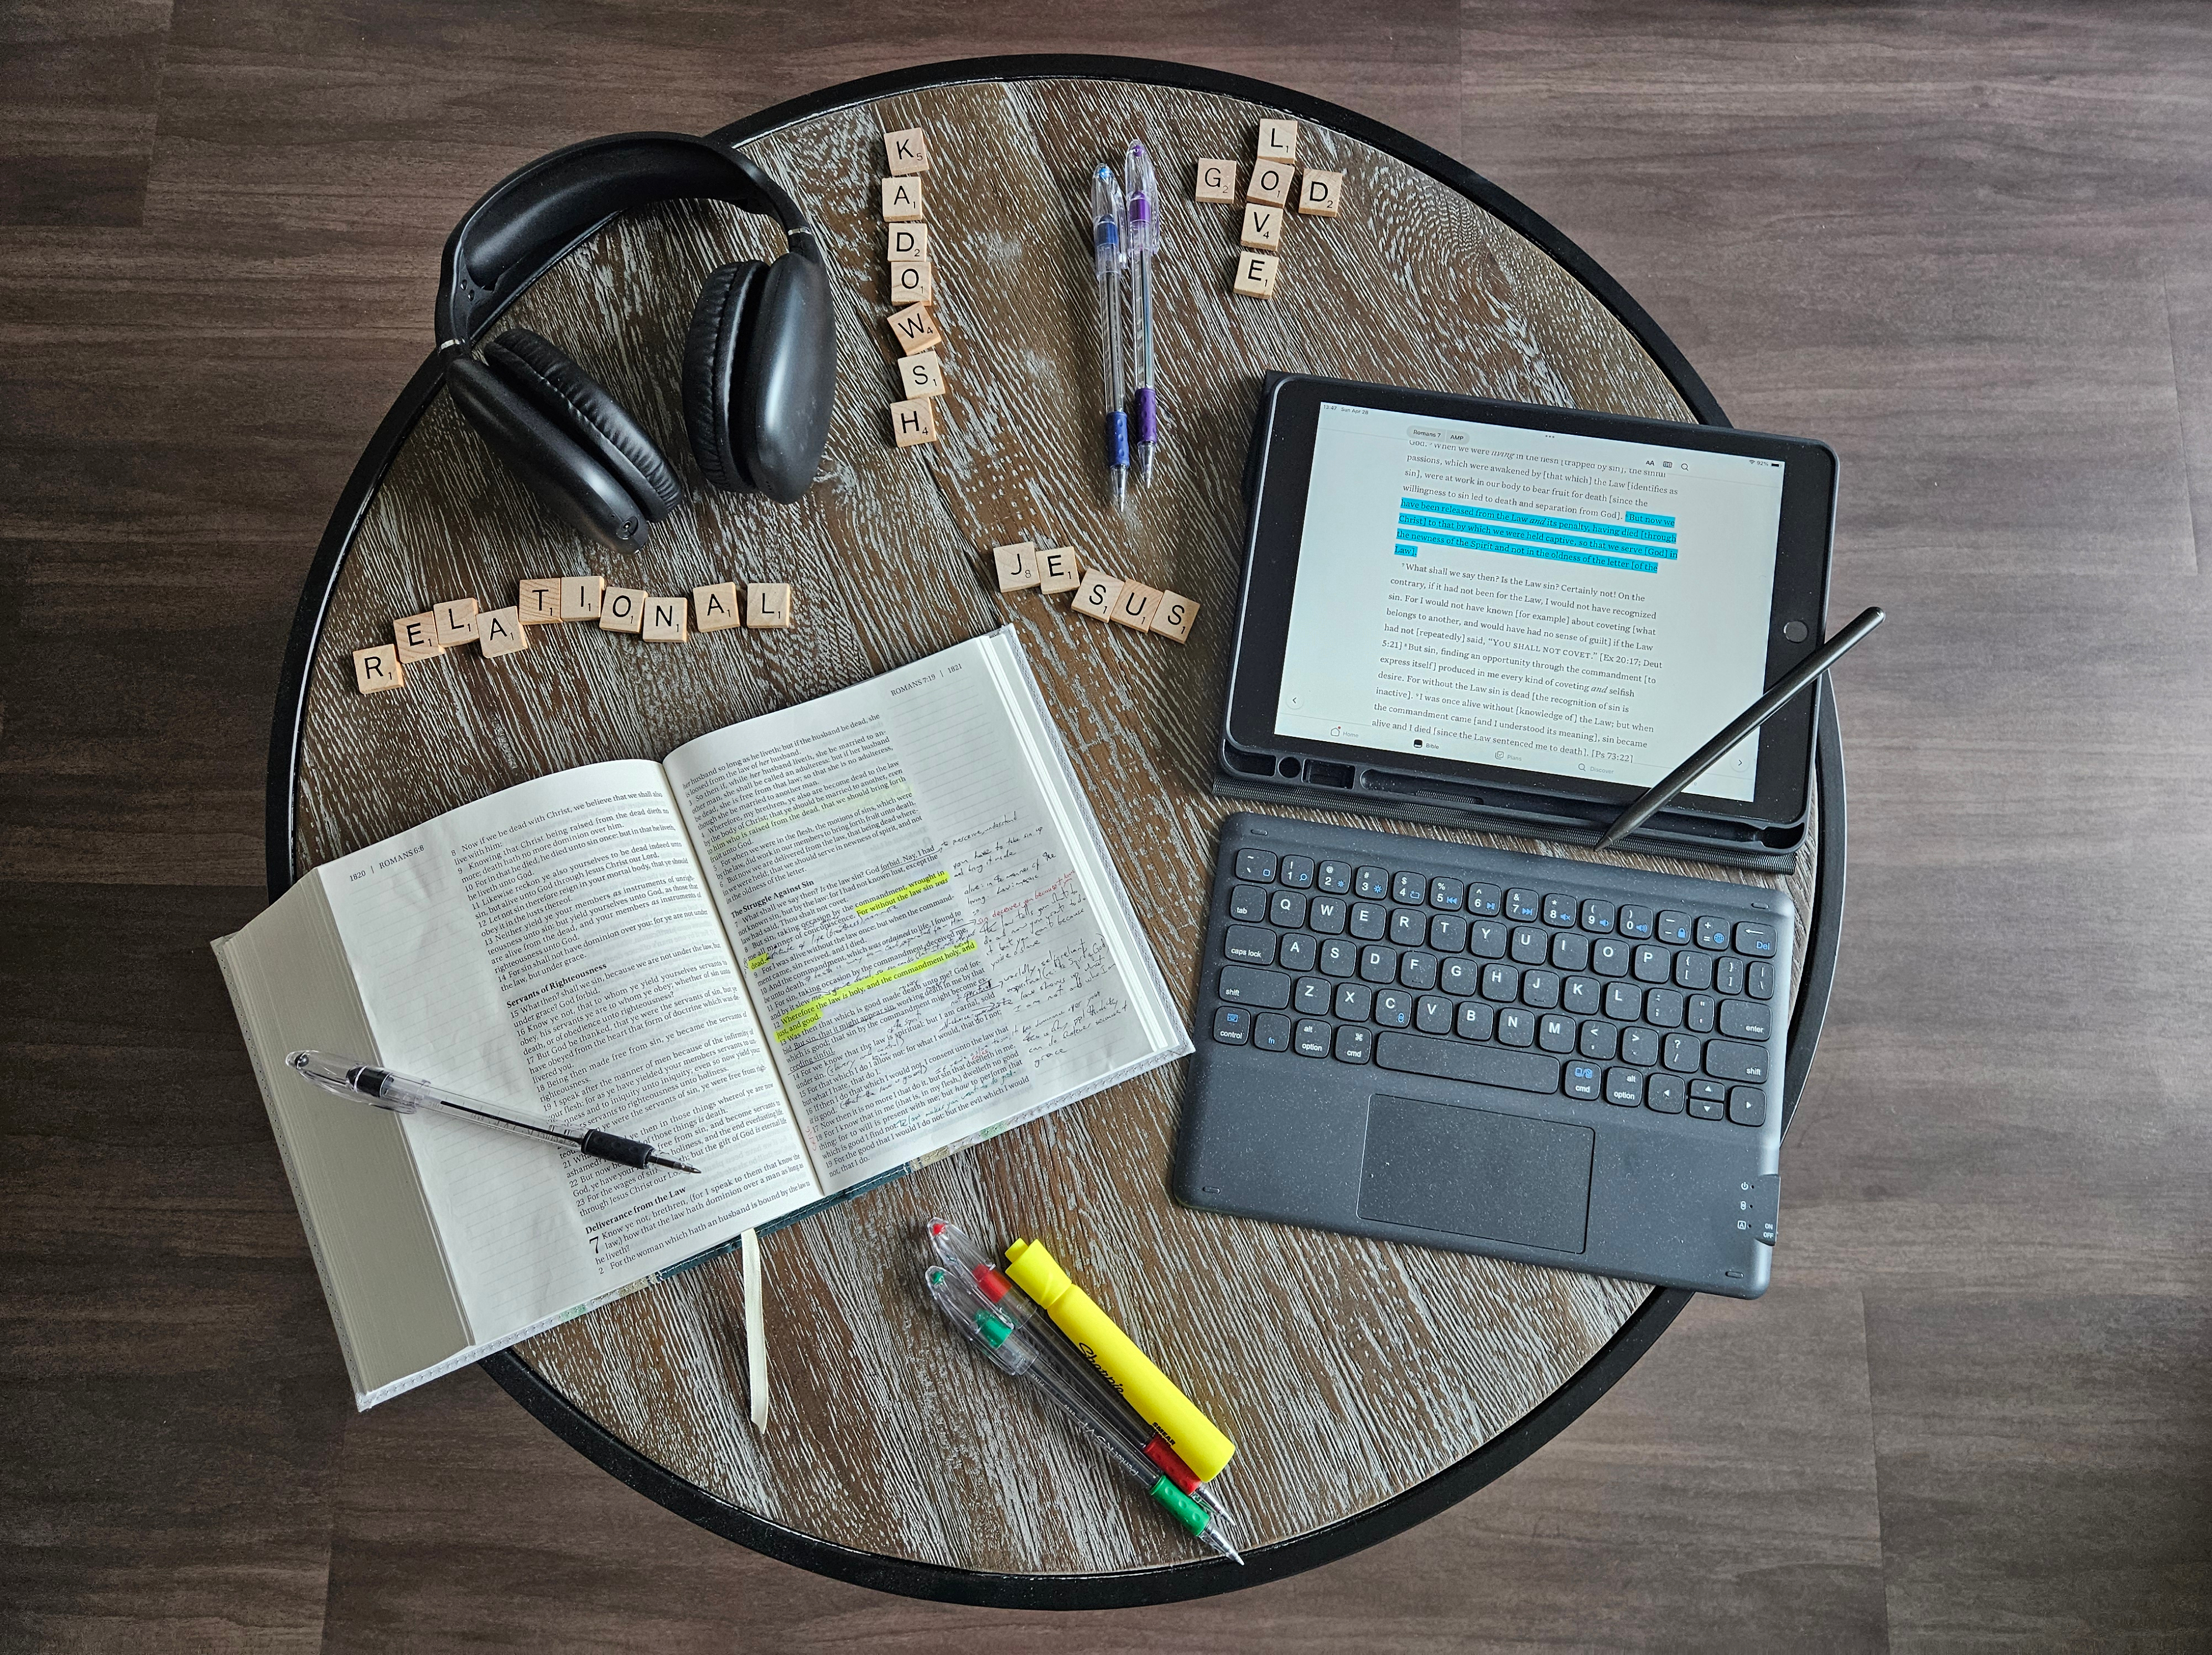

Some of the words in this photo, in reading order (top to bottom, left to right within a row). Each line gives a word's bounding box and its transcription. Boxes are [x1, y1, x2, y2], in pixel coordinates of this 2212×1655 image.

[1413, 429, 1436, 438] Romans
[1406, 455, 1442, 466] passions,
[1445, 459, 1468, 468] which
[1490, 466, 1530, 476] awakened
[1531, 469, 1541, 479] by
[1543, 471, 1563, 481] [that
[1565, 474, 1592, 485] which]
[1594, 477, 1607, 486] the
[1608, 480, 1626, 488] Law
[1627, 481, 1668, 494] [identifies
[1401, 498, 1420, 508] have
[1421, 501, 1440, 511] been
[1441, 505, 1474, 516] released
[1475, 509, 1494, 519] from
[1497, 512, 1510, 521] the
[1510, 514, 1528, 523] Law
[1547, 518, 1557, 527] its
[1559, 522, 1590, 532] penalty,
[1592, 524, 1620, 537] having
[1621, 528, 1639, 538] died
[1640, 530, 1676, 543] [through
[1384, 623, 1399, 633] had
[1416, 628, 1465, 643] [repeatedly]
[1466, 636, 1486, 646] said,
[1513, 642, 1541, 652] SHALL
[1543, 646, 1561, 655] NOT
[1600, 653, 1614, 662] [Ex
[1615, 655, 1641, 667] 20:17;
[1643, 659, 1663, 669] Deut
[890, 679, 923, 696] ROMANS
[922, 674, 936, 683] 7:19
[947, 663, 962, 674] 1821
[1590, 766, 1614, 774] Discover
[454, 856, 468, 866] live
[468, 848, 485, 860] with
[484, 842, 503, 853] him:
[350, 870, 366, 882] 1820
[378, 849, 415, 870] ROMANS
[412, 845, 424, 855] 6:8
[1325, 877, 1331, 886] 2
[1362, 882, 1368, 891] 3
[1400, 888, 1406, 896] 4
[1437, 893, 1443, 902] 5
[730, 909, 743, 919] The
[742, 896, 772, 913] Struggle
[773, 884, 802, 899] Against
[801, 880, 815, 888] Sin
[856, 909, 868, 918] For
[869, 898, 896, 912] without
[897, 893, 908, 902] the
[908, 888, 921, 897] law
[935, 878, 948, 887] was
[1474, 899, 1481, 907] 6
[1280, 899, 1291, 910] Q
[1321, 904, 1334, 916] W
[1513, 904, 1519, 913] 7
[1359, 910, 1369, 922] E
[1550, 910, 1556, 918] 8
[1588, 915, 1595, 924] 9
[1400, 916, 1409, 928] R
[1441, 922, 1449, 933] T
[1627, 921, 1633, 929] 0
[1482, 928, 1491, 939] Y
[1521, 934, 1530, 945] U
[1561, 940, 1565, 950] I
[1290, 941, 1299, 953] A
[1756, 941, 1769, 950] Del
[1331, 948, 1339, 958] S
[1603, 946, 1613, 957] O
[1644, 952, 1653, 962] P
[1370, 953, 1380, 964] D
[1410, 959, 1419, 970] F
[1451, 966, 1461, 976] G
[1492, 971, 1501, 982] H
[506, 990, 541, 1008] Servants
[541, 984, 549, 993] of
[549, 964, 607, 990] Righteousness
[1533, 978, 1540, 988] J
[773, 1021, 781, 1029] 12
[780, 1007, 816, 1025] Wherefore
[816, 1001, 828, 1009] the
[828, 996, 841, 1005] law
[848, 987, 866, 997] holy,
[866, 979, 880, 990] and
[894, 955, 944, 979] commandment
[944, 949, 961, 959] holy,
[1305, 985, 1314, 997] Z
[1573, 983, 1583, 995] K
[1345, 991, 1355, 1003] X
[1615, 990, 1622, 1001] L
[1385, 998, 1395, 1009] C
[1427, 1003, 1436, 1014] V
[1467, 1009, 1476, 1021] B
[776, 1028, 789, 1040] just,
[789, 1021, 802, 1032] and
[802, 1013, 821, 1028] good.
[1508, 1016, 1518, 1028] N
[1549, 1022, 1560, 1034] M
[1302, 1043, 1322, 1052] option
[1746, 1068, 1761, 1076] shift
[1614, 1091, 1634, 1100] option
[585, 1210, 634, 1235] Deliverance
[632, 1201, 654, 1214] from
[654, 1195, 668, 1204] the
[668, 1186, 686, 1199] Law
[1152, 1422, 1176, 1446] SMEAR
[1113, 1451, 1139, 1476] Pentel
